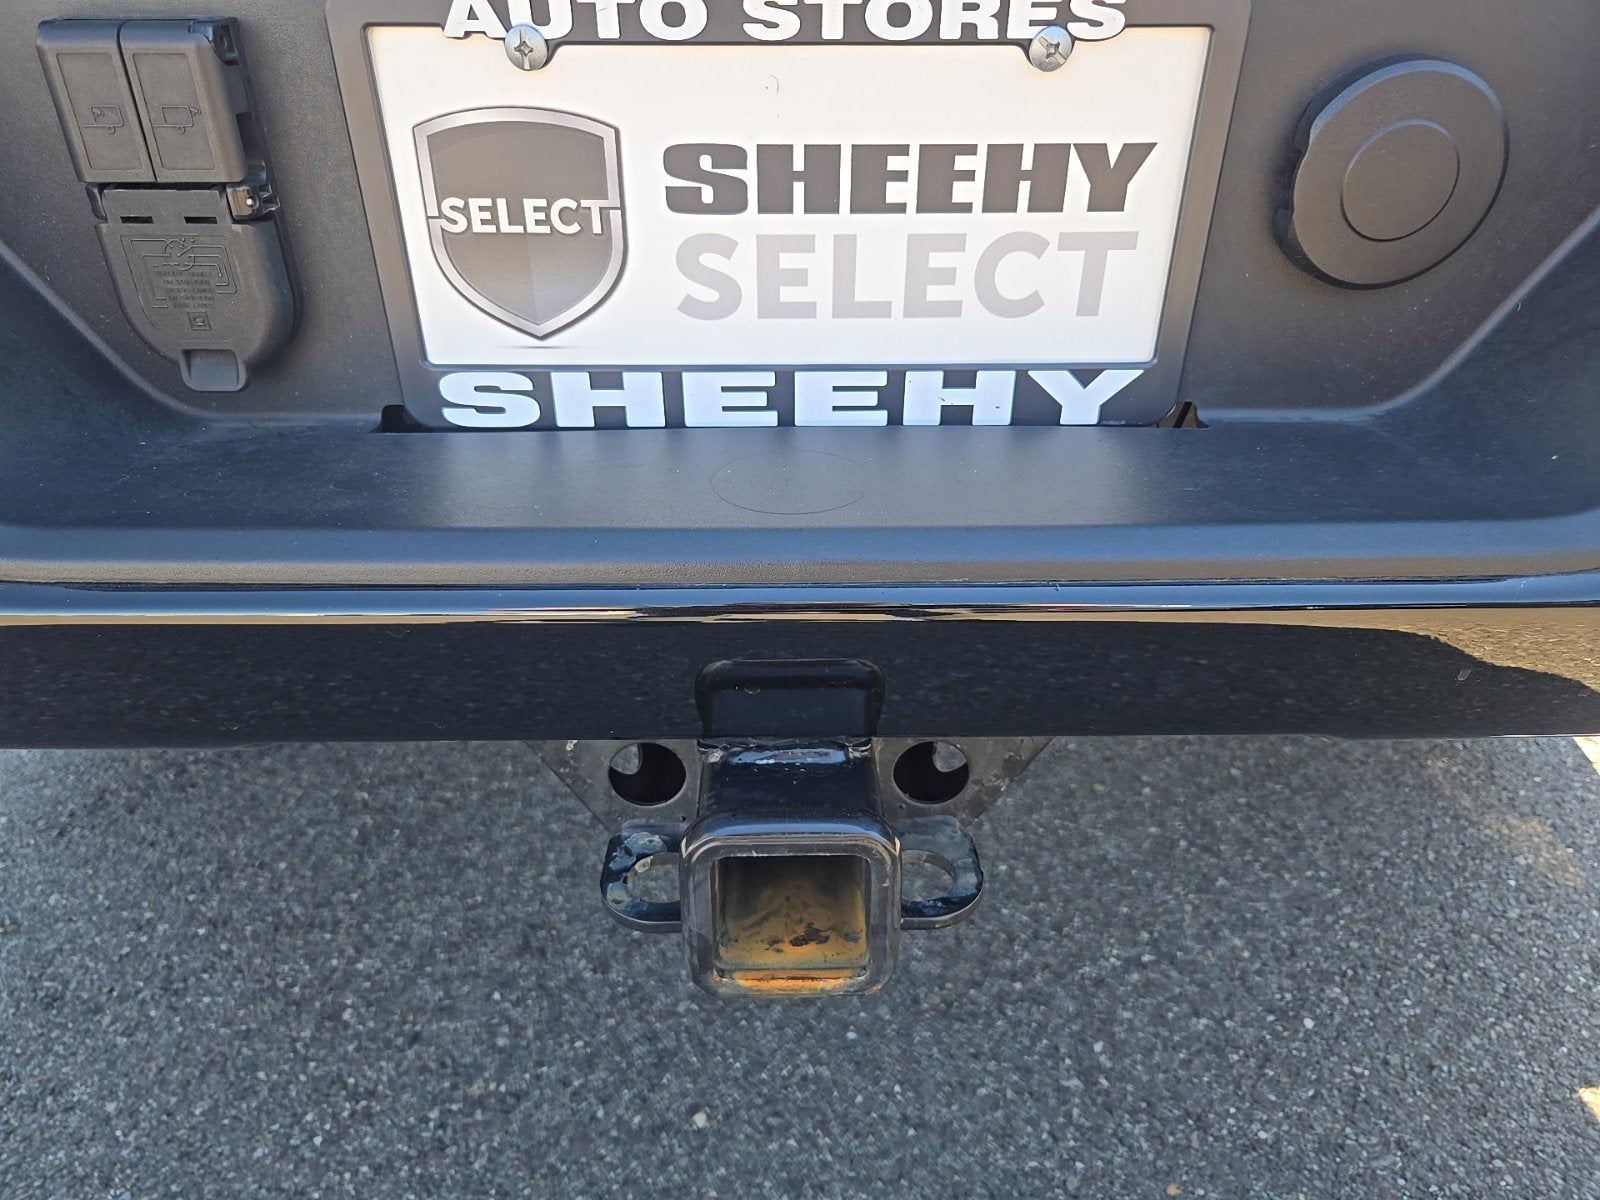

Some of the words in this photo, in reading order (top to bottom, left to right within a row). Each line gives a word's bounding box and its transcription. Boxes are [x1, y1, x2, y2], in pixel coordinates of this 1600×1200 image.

[443, 0, 708, 41] AUTO
[742, 0, 1126, 41] STORES
[663, 142, 1158, 215] SHEEHY
[440, 197, 612, 234] SELECT
[675, 230, 1140, 321] SELECT
[438, 369, 1145, 428] SHEEHY
